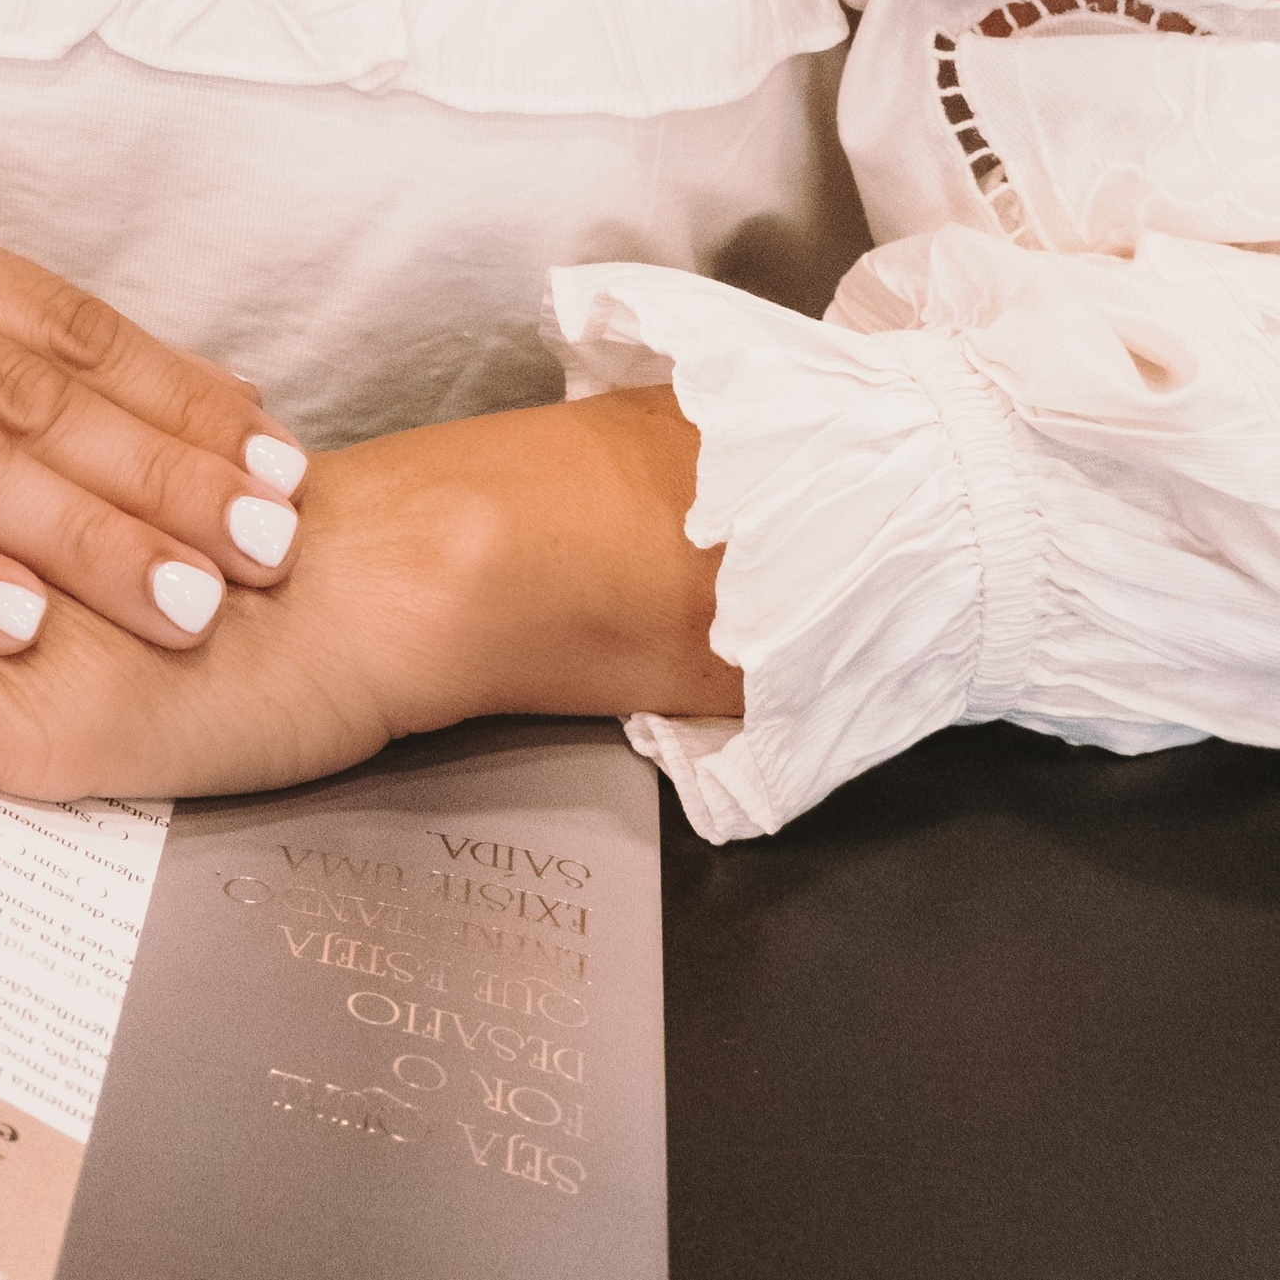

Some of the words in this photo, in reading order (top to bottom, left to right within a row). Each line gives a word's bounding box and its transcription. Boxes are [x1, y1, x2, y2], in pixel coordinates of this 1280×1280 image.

[33, 854, 70, 879] Sim
[84, 849, 145, 884] algum
[276, 844, 408, 893] UMA
[426, 831, 592, 891] SAÍDA.
[42, 881, 75, 903] seu
[80, 902, 104, 920] do
[431, 869, 592, 938] EXISTE
[9, 917, 32, 933] as
[77, 934, 114, 957] vier
[39, 933, 86, 963] para
[276, 924, 453, 993] ESTEJA
[473, 969, 590, 1028] QUE
[347, 991, 590, 1086] DESAFIO
[392, 1054, 448, 1091] O
[469, 1070, 588, 1142] FOR
[456, 1121, 586, 1196] SEJA
